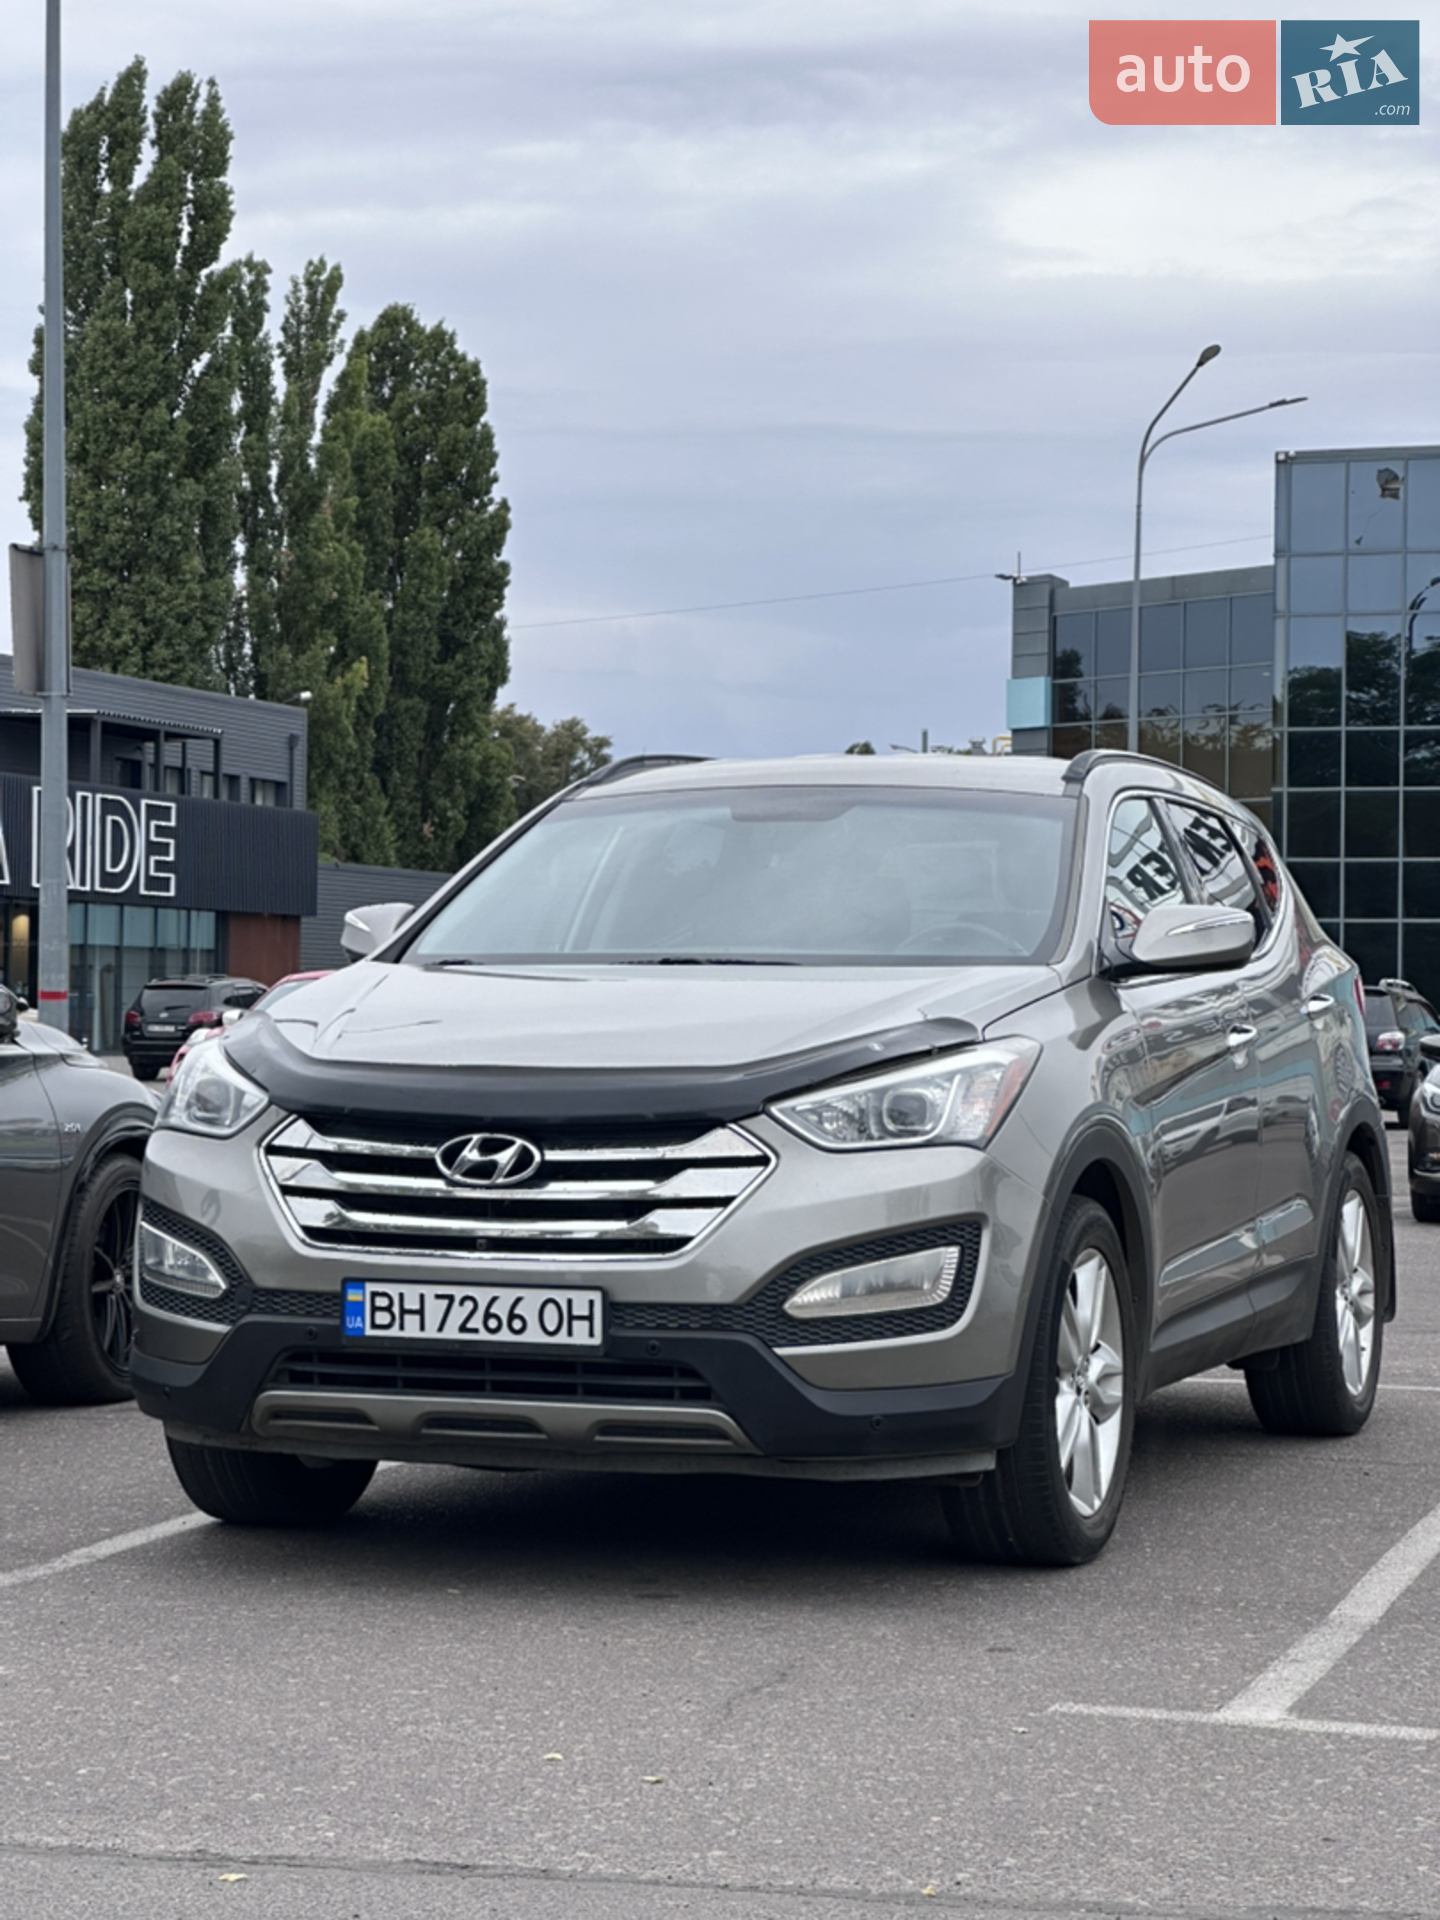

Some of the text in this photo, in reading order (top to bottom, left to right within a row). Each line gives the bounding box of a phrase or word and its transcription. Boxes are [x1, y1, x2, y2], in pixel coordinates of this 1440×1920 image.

[345, 1316, 363, 1329] UA
[369, 1290, 595, 1338] BH 7266 OH
